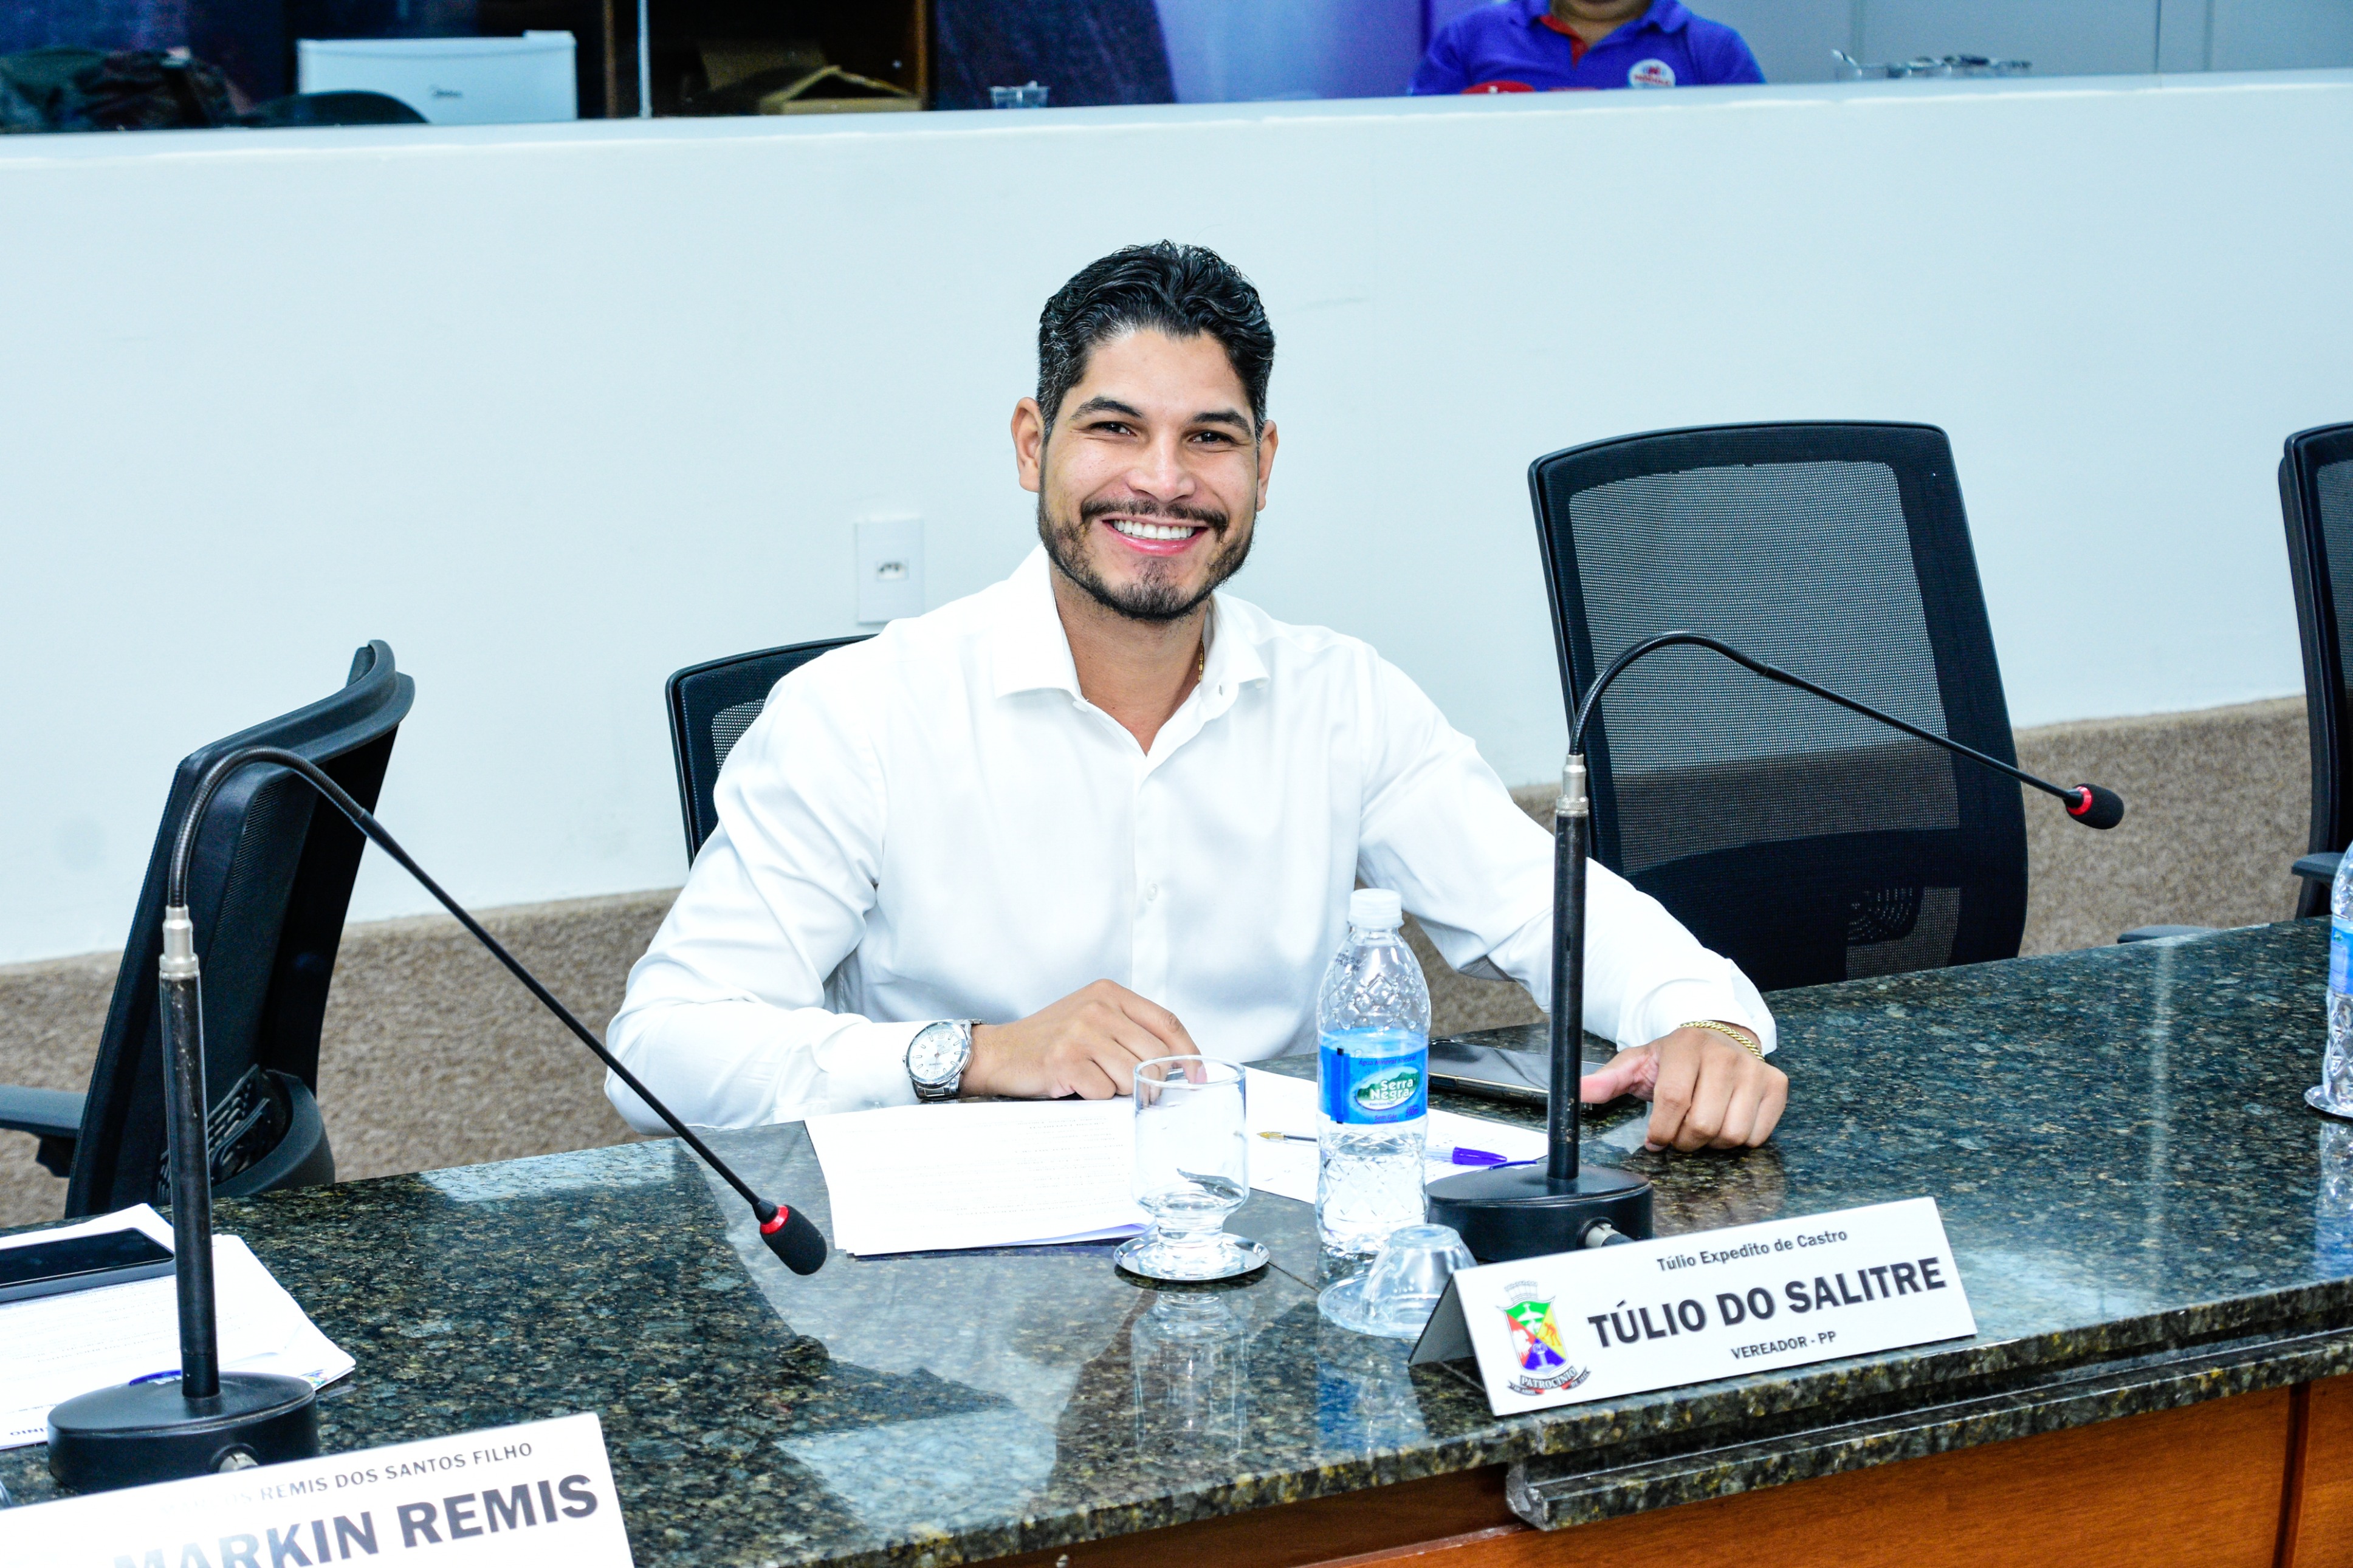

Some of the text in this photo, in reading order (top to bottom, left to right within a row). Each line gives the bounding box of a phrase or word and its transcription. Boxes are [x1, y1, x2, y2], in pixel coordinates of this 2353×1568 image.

[1369, 1088, 1410, 1102] Negra
[1380, 1078, 1414, 1092] Serra
[1657, 1230, 1847, 1272] Túlio Expedito de Castro
[1587, 1256, 1947, 1348] TÚLIO DO SALITRE
[1731, 1336, 1808, 1360] VEREADOR
[1818, 1330, 1836, 1344] PP
[260, 1477, 328, 1501] REMIS
[335, 1469, 378, 1488] DOS
[385, 1454, 465, 1479] SANTOS
[473, 1443, 532, 1465] FILHO
[396, 1474, 599, 1549] REMIS
